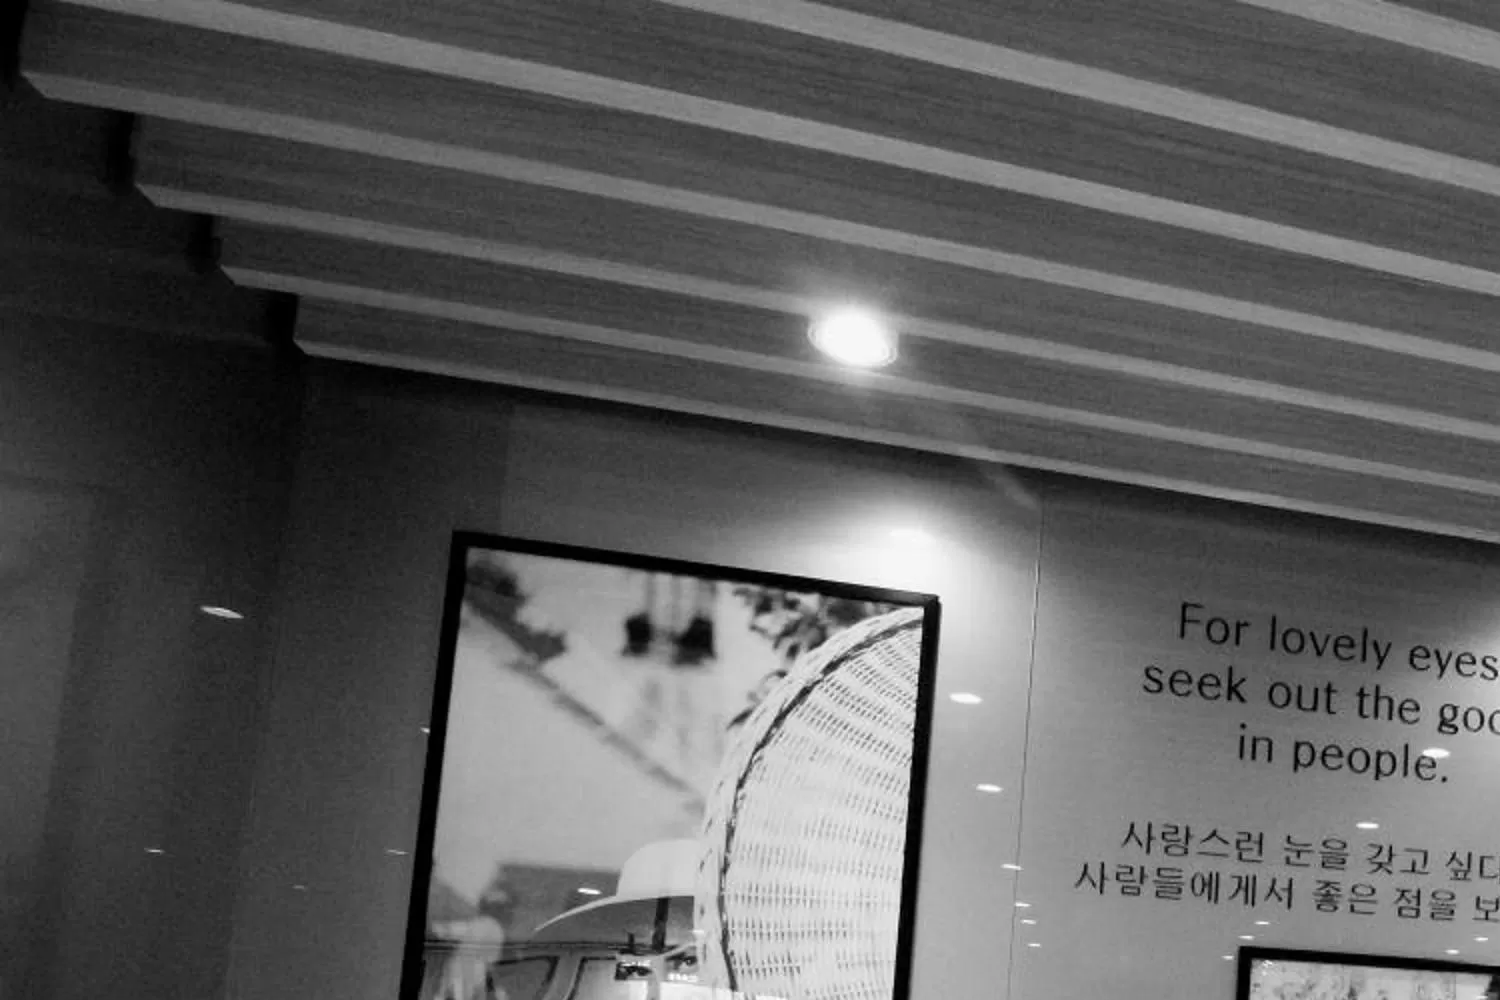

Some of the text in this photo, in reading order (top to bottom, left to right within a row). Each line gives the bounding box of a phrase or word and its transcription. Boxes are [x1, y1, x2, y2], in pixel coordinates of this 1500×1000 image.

[1178, 601, 1252, 648] For
[1269, 615, 1393, 672] lovely
[1141, 664, 1248, 705] seek
[1267, 681, 1339, 717] out
[1355, 685, 1421, 726] the
[1237, 722, 1450, 784] in people.
[1120, 820, 1265, 865] 사랑스런
[1283, 834, 1350, 872] 눈을
[1366, 842, 1430, 877] 갖고
[1073, 860, 1294, 912] 사람들에게서
[1311, 879, 1379, 917] 좋은
[1393, 887, 1457, 922] 점을
